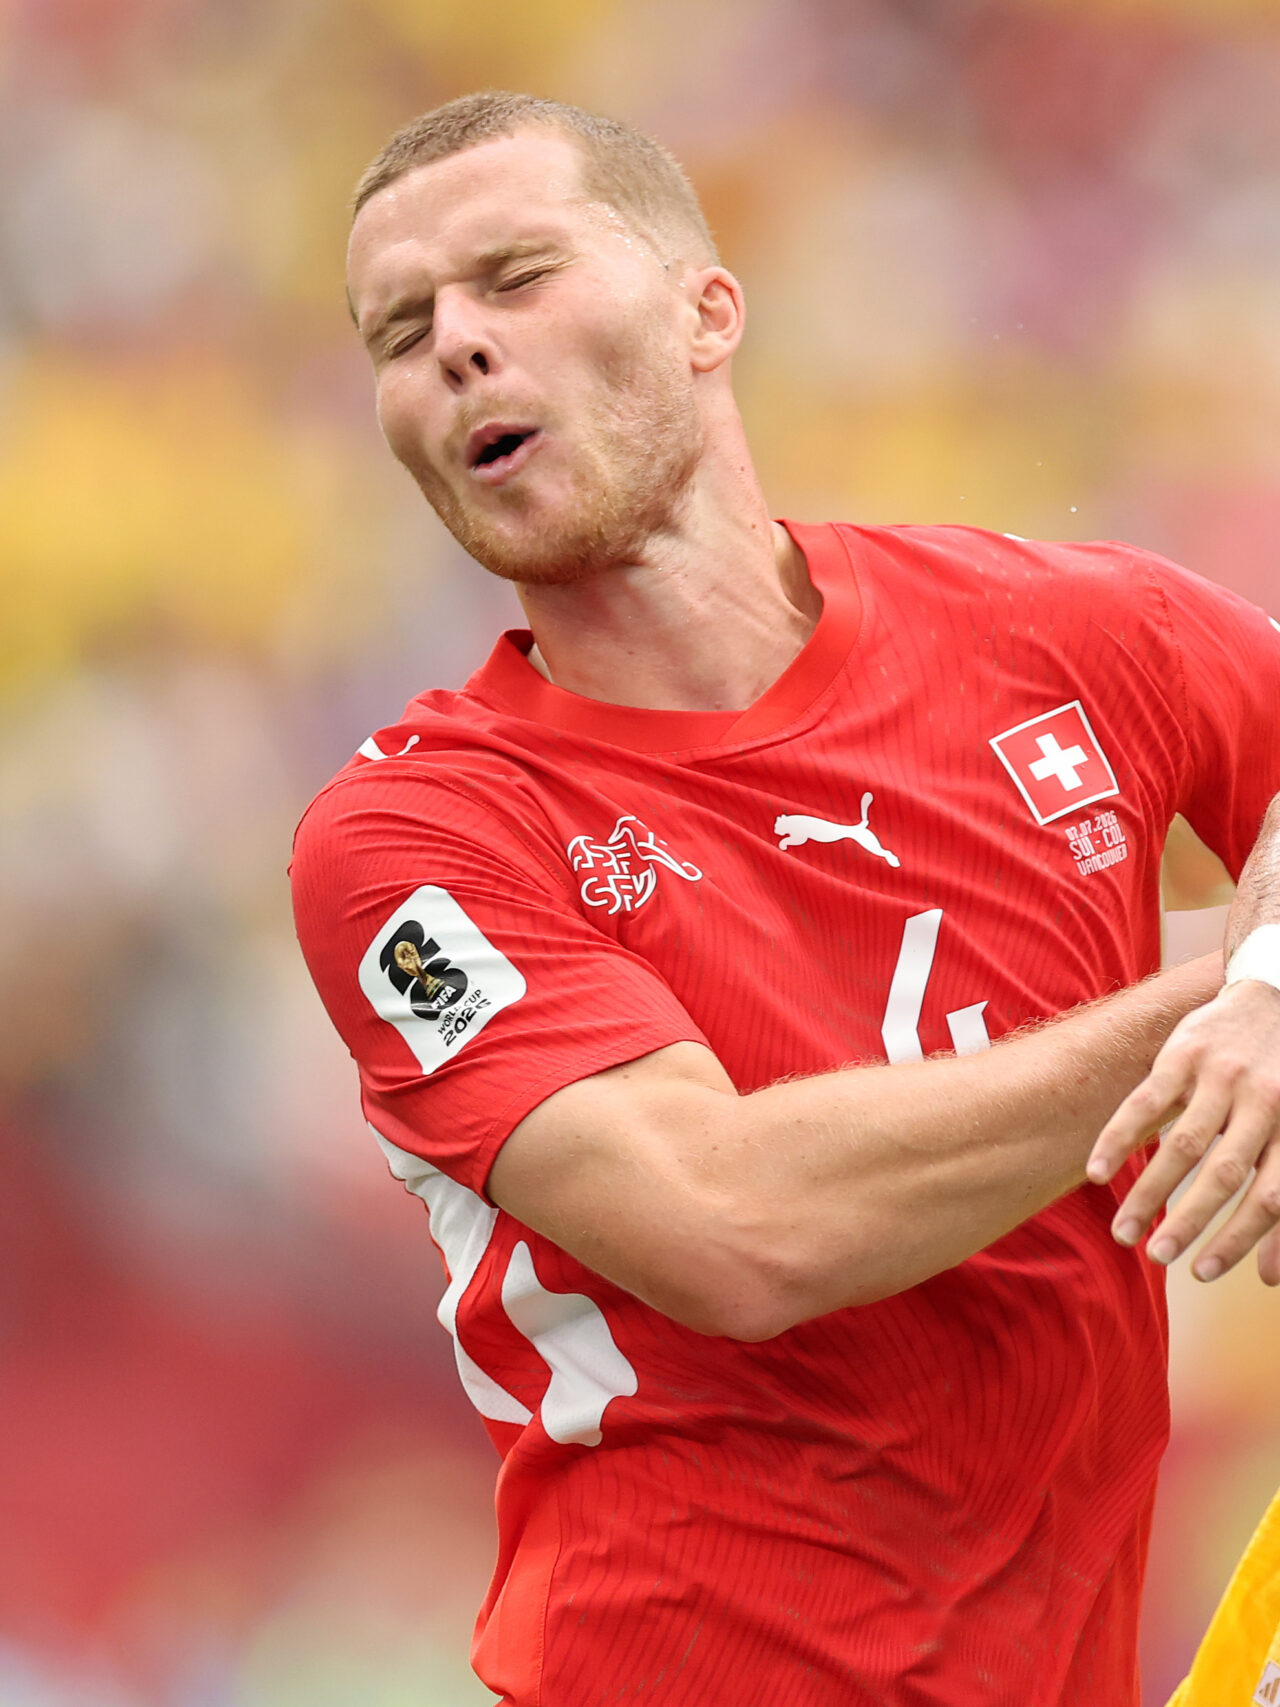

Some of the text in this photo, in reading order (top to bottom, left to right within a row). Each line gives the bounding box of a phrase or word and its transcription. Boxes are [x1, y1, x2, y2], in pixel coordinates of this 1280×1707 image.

[1068, 835, 1096, 861] SUI
[1101, 823, 1126, 848] COL
[430, 984, 458, 1011] FIFA
[463, 988, 483, 1009] CUP
